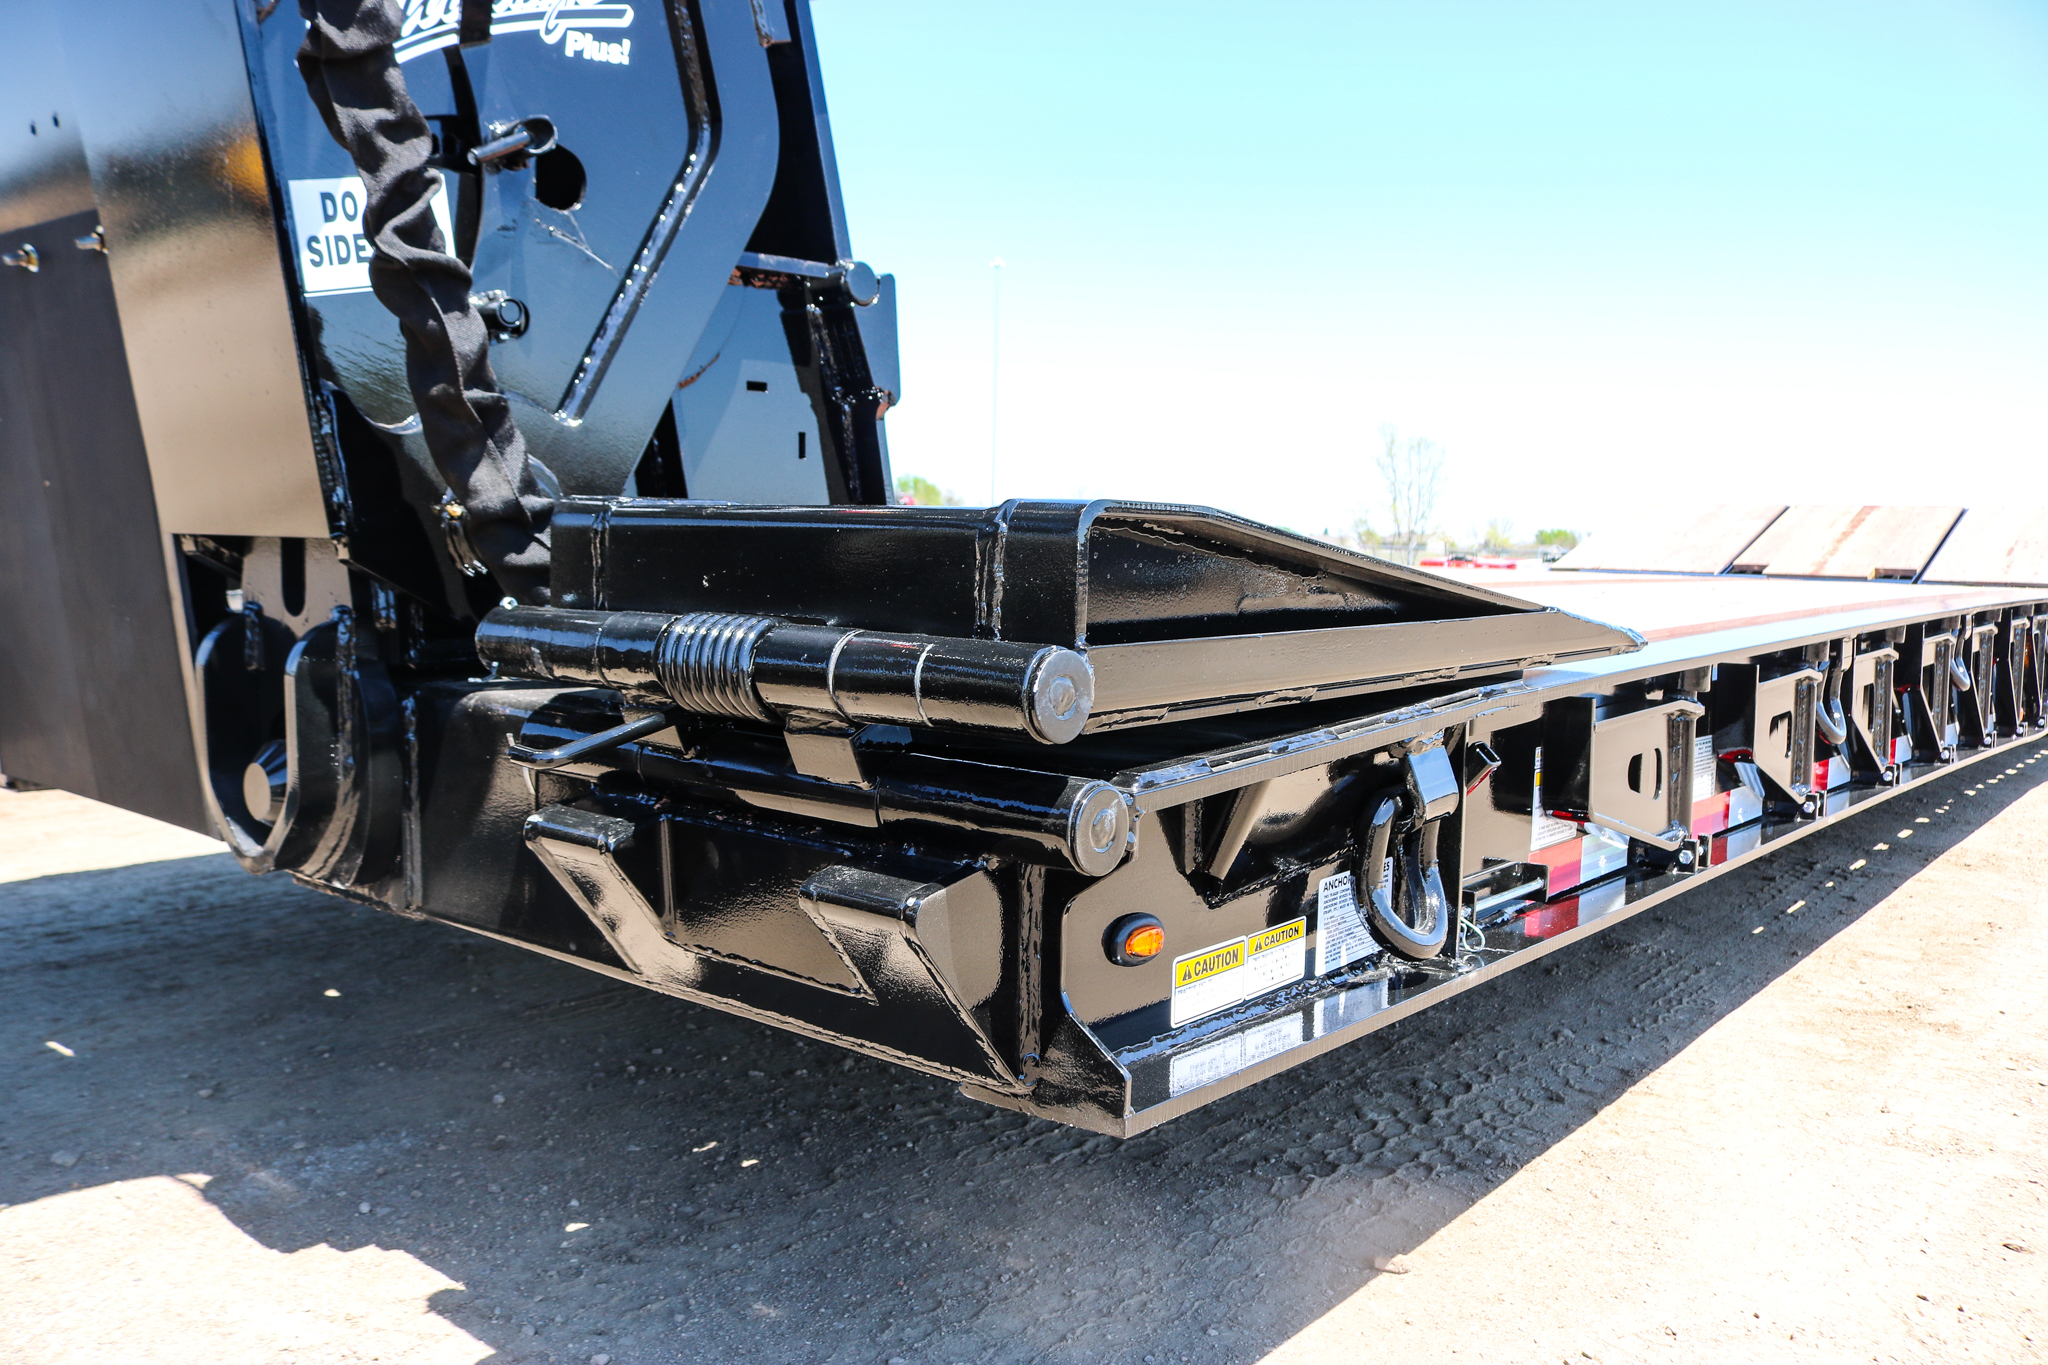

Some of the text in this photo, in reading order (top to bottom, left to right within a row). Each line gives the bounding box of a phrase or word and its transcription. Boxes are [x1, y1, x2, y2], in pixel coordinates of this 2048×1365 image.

[565, 30, 632, 66] Plus!
[320, 190, 358, 223] DO
[1263, 925, 1299, 947] CAUTION
[1194, 947, 1239, 977] CAUTION
